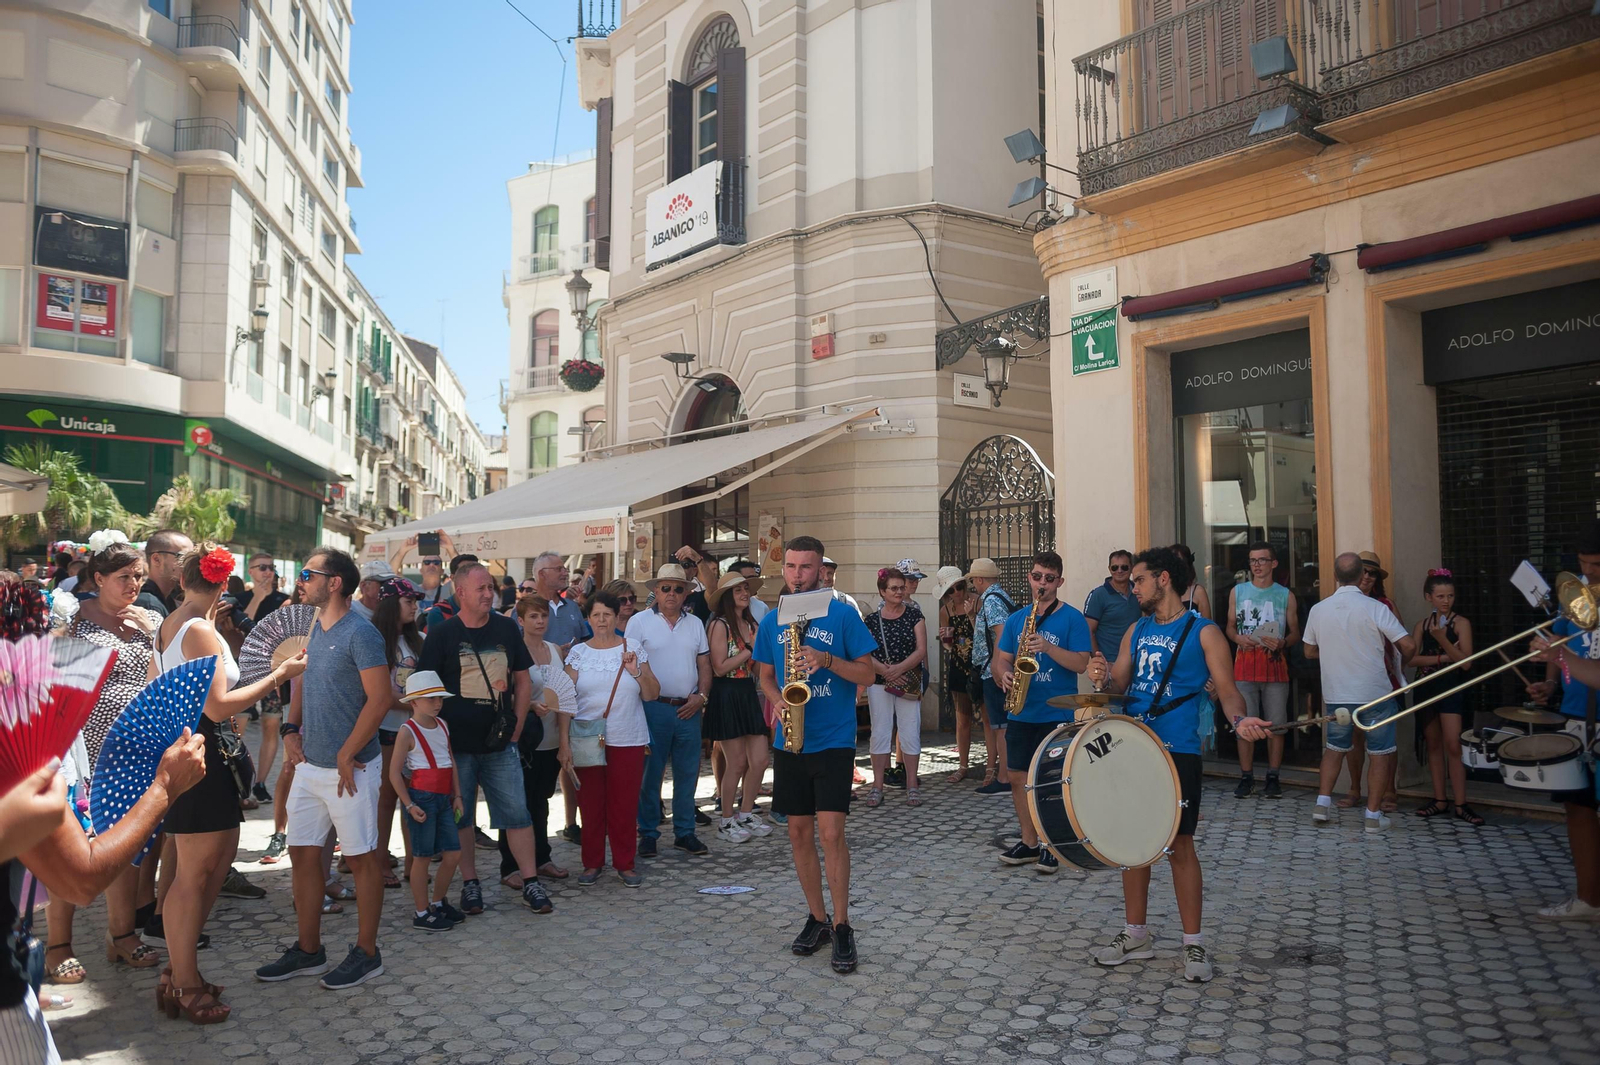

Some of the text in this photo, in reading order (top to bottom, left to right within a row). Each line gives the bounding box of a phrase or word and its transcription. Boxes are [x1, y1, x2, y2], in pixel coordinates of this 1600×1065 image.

[652, 211, 709, 248] ABANICO '19
[1077, 283, 1089, 292] CALLE
[1078, 290, 1102, 303] GRANADA
[1072, 318, 1084, 328] VIA
[1073, 319, 1116, 336] EVACUACION
[1448, 328, 1515, 351] ADOLFO
[1080, 362, 1098, 371] Molina
[1098, 358, 1116, 367] Larios
[1185, 371, 1233, 388] ADOLFO
[60, 416, 117, 435] Unicaja
[1083, 732, 1113, 764] NP
